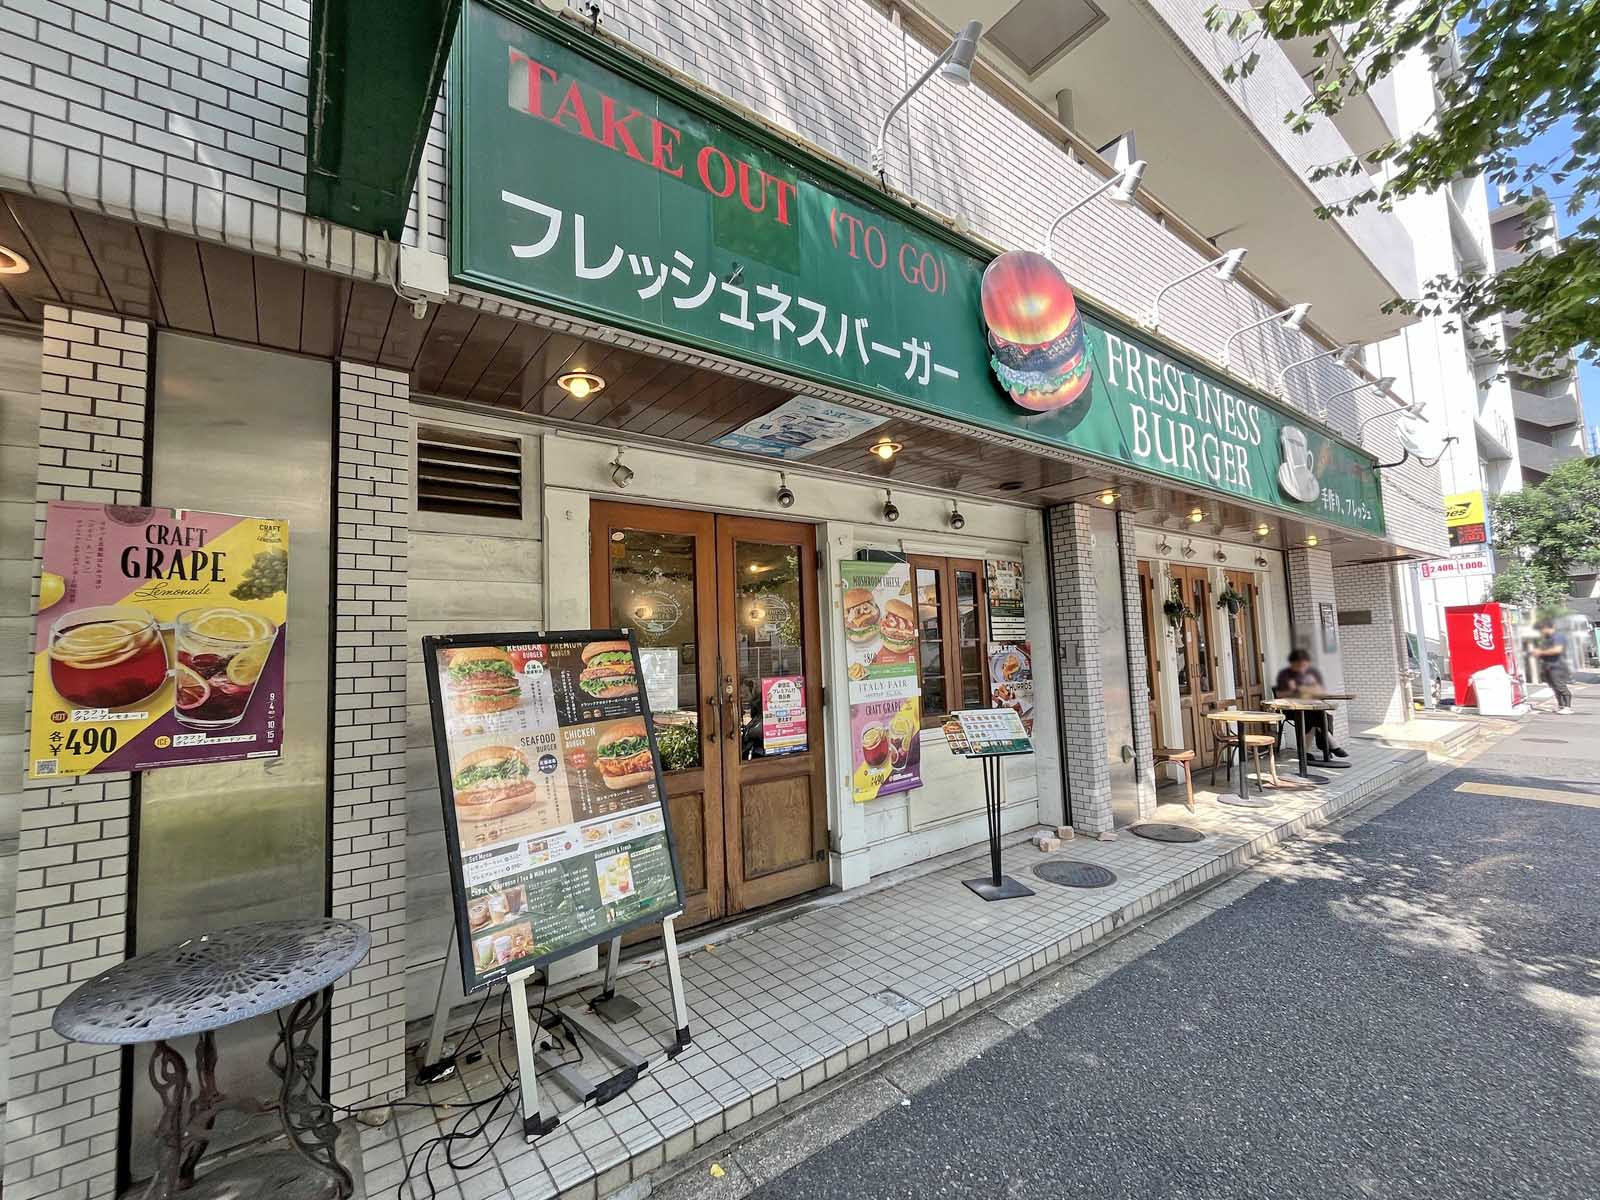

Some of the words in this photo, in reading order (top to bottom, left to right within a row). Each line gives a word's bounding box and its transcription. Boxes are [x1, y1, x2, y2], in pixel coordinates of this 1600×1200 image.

[509, 50, 684, 178] TAKE
[696, 145, 797, 227] OUT
[829, 207, 888, 270] (TO
[898, 242, 947, 297] GO)
[501, 189, 960, 386] フレッシュネスバーガー
[1103, 330, 1262, 446] FRESHNESS
[1129, 402, 1253, 490] BURGER
[145, 524, 208, 548] CRAFT
[120, 546, 227, 583] GRAPE
[134, 582, 210, 600] Lemonade
[858, 680, 885, 692] ITALY
[887, 679, 909, 689] FAIR
[520, 733, 556, 747] SEAFOOD
[564, 727, 596, 741] CHICKEN
[536, 744, 557, 753] BURGER
